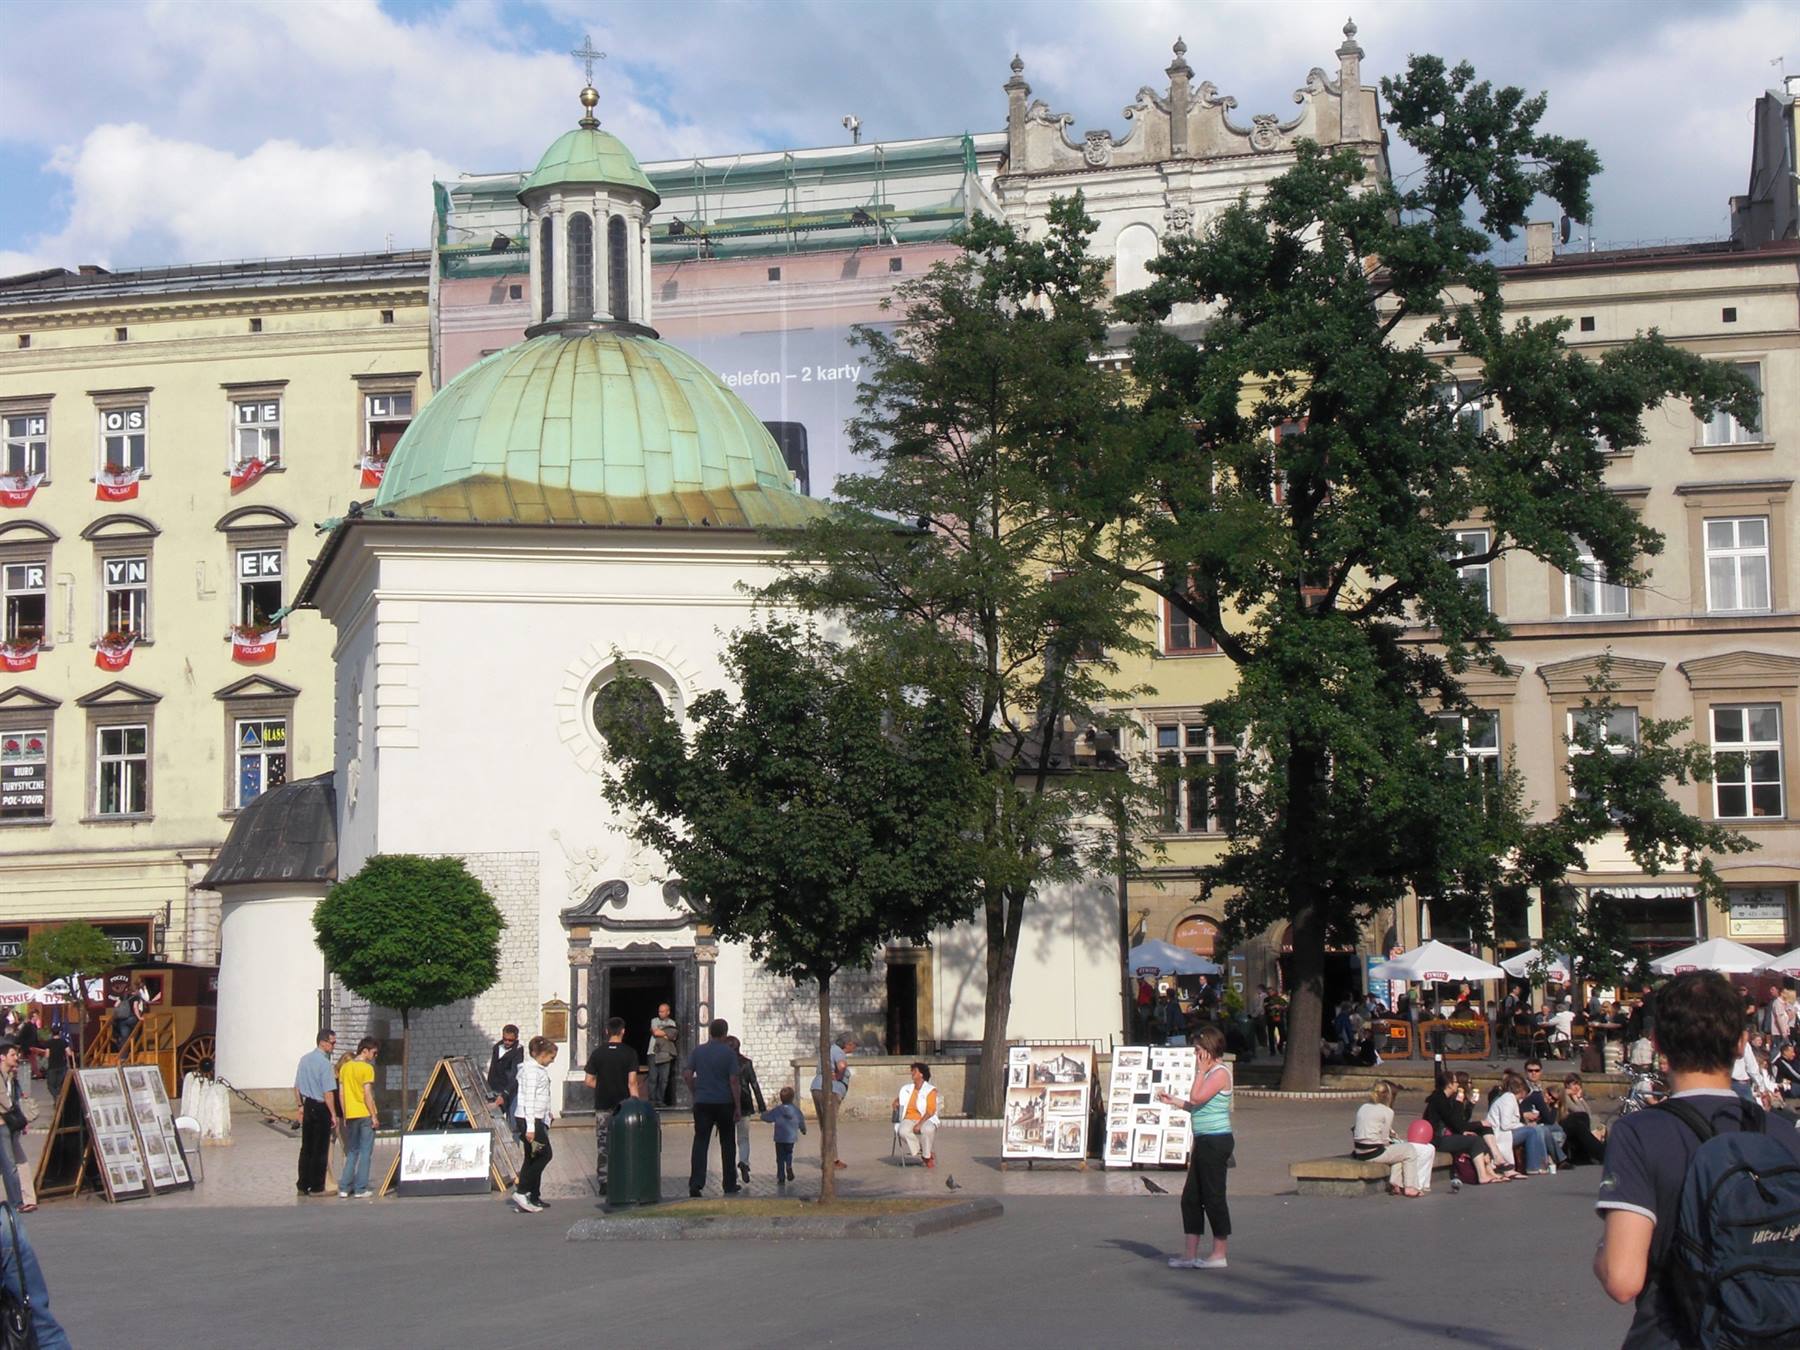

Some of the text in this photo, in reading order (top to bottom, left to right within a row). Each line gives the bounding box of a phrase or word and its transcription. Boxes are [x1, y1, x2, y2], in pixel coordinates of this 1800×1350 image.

[721, 370, 780, 387] telefon
[801, 367, 812, 382] 2
[817, 364, 861, 382] karty
[14, 767, 34, 777] BIURO
[2, 780, 45, 791] TURYSTYCZNE
[2, 795, 44, 805] POL-TOUR
[1752, 1230, 1781, 1244] Ultra
